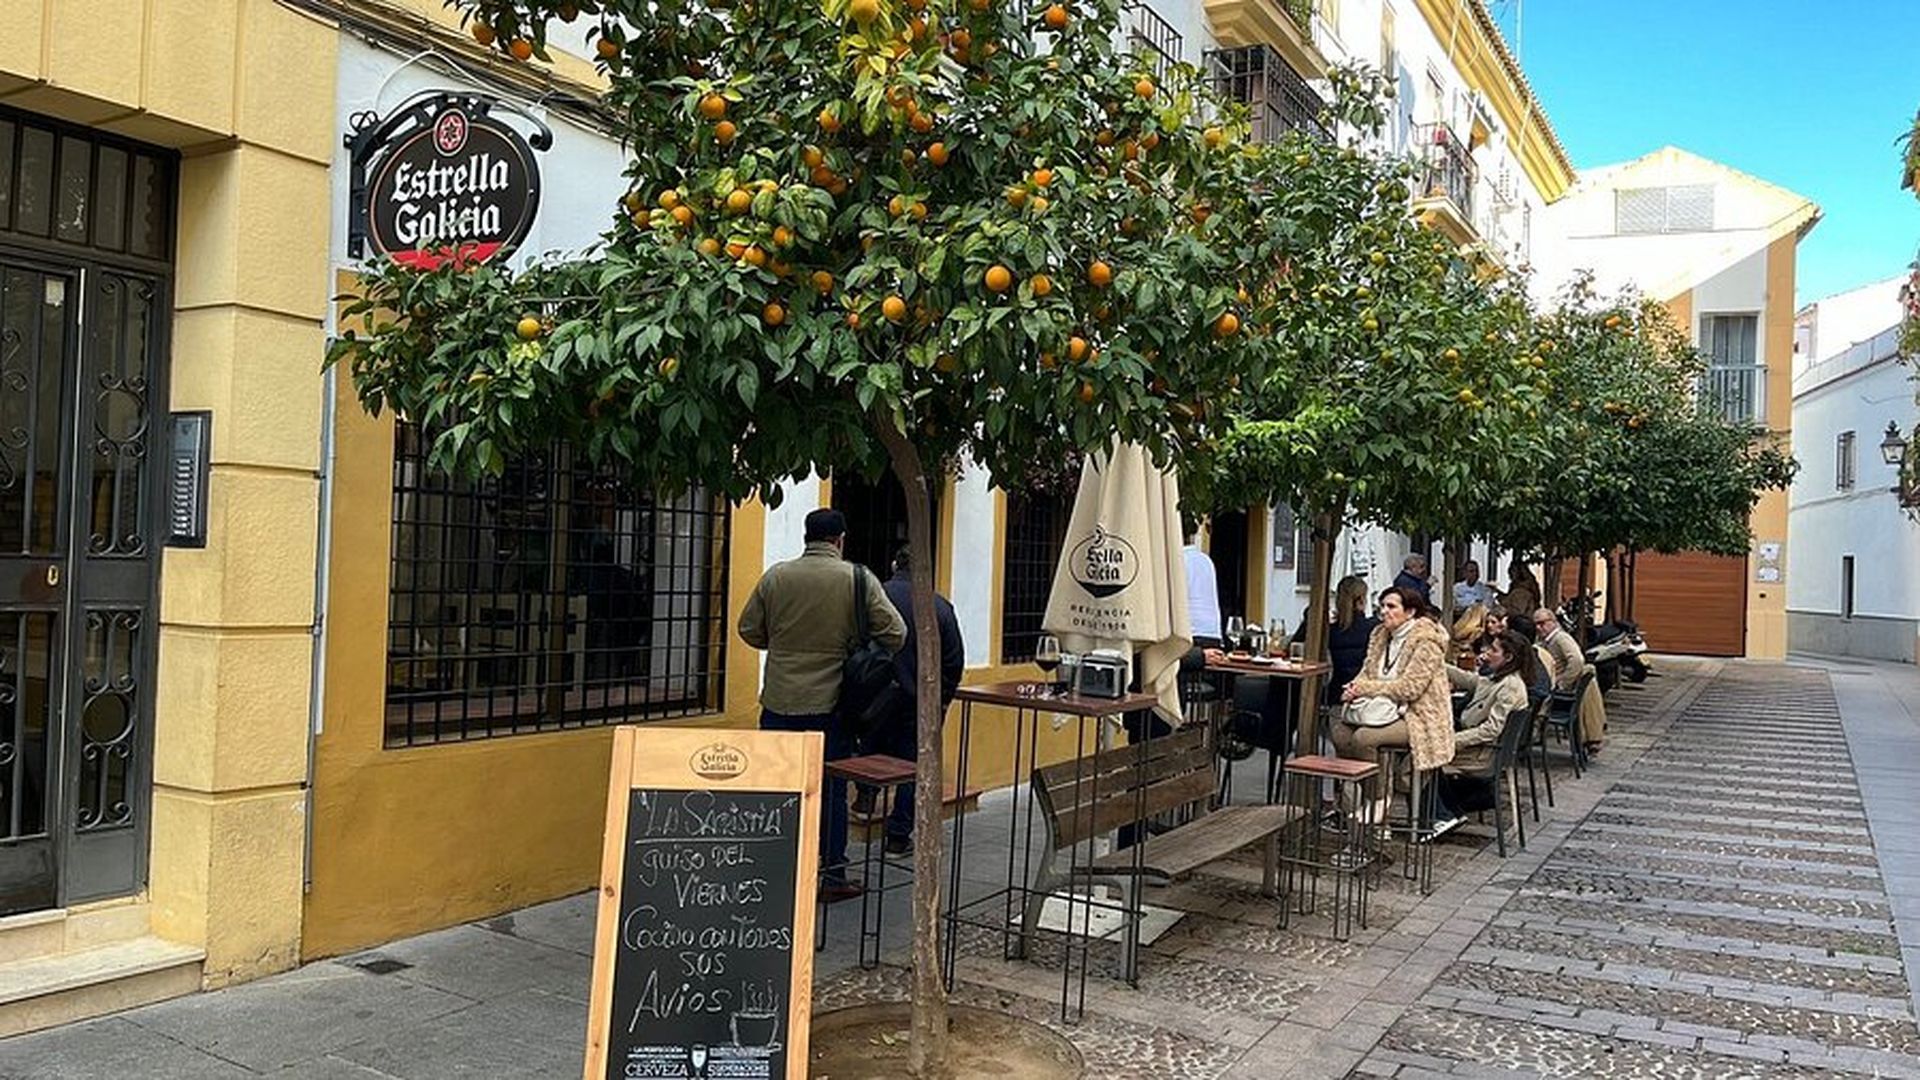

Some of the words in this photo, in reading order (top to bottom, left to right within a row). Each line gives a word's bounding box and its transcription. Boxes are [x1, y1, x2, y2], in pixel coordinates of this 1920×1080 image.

[390, 153, 509, 202] Estrella
[395, 196, 502, 245] Galicia
[711, 842, 754, 868] DEL
[624, 1062, 689, 1077] CERVEZA
